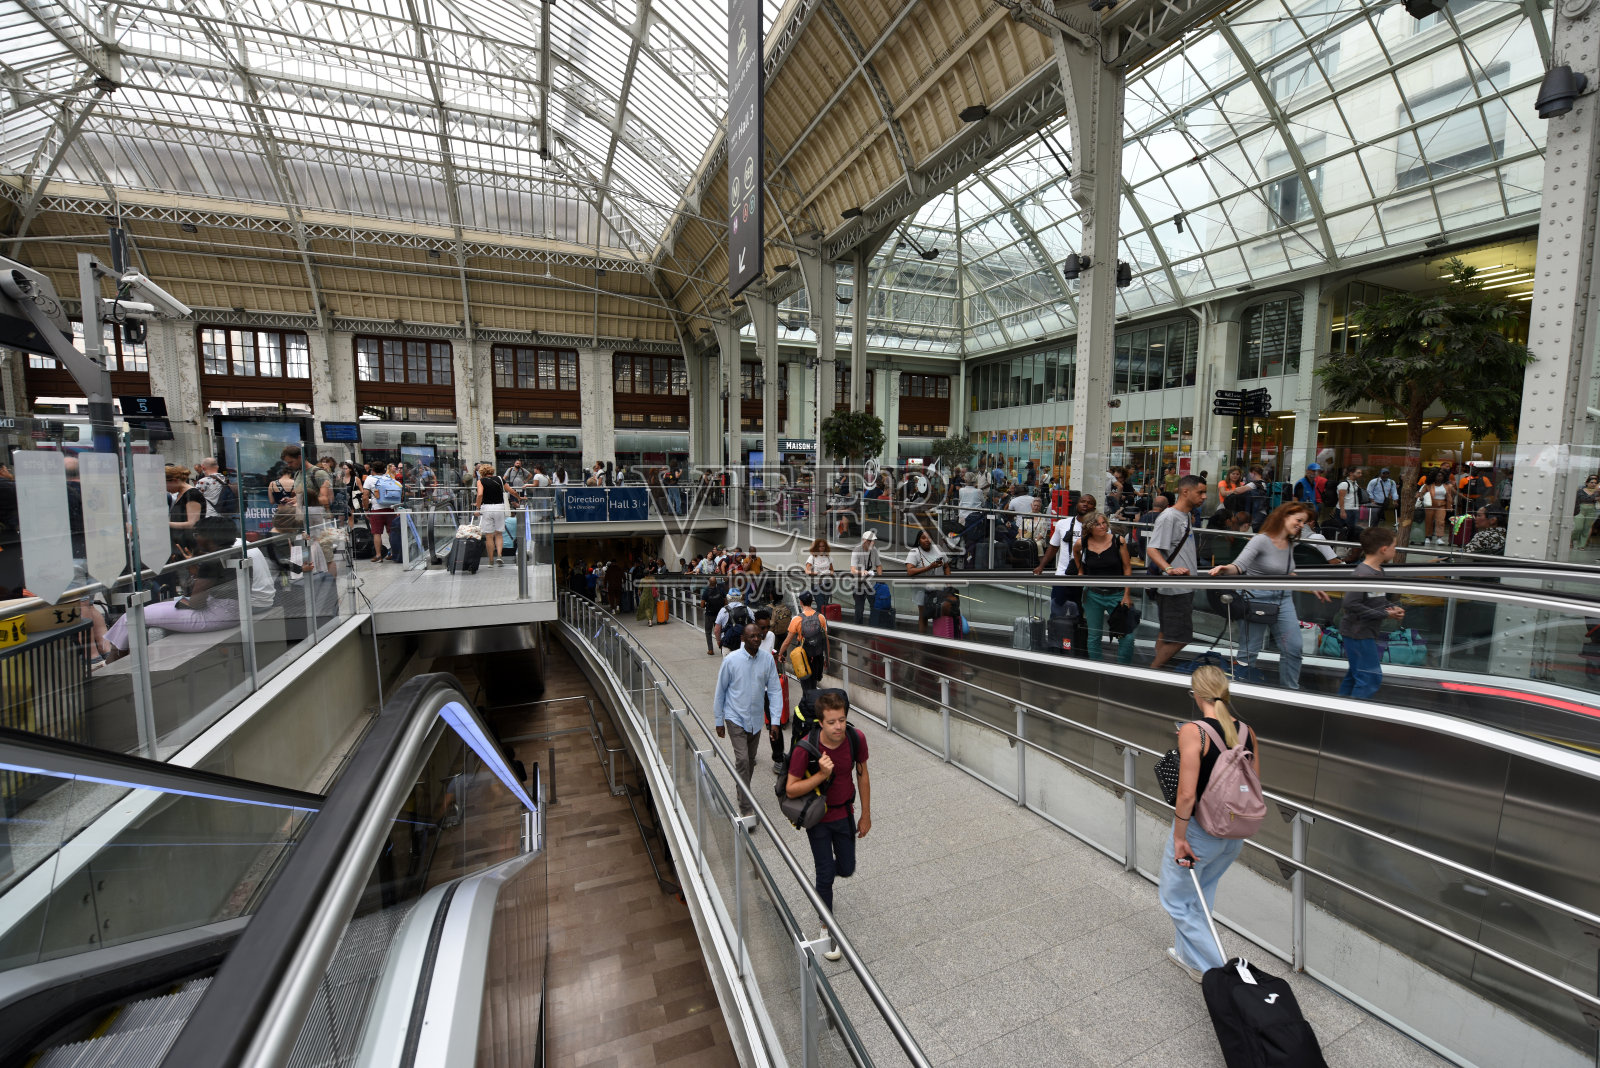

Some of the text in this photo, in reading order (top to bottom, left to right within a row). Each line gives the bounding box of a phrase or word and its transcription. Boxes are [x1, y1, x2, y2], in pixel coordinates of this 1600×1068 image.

[738, 111, 750, 141] Hall
[750, 103, 754, 121] 3
[139, 402, 148, 412] 5
[567, 495, 605, 504] Direction
[609, 499, 638, 509] Hall 3
[245, 507, 270, 519] AGENT
